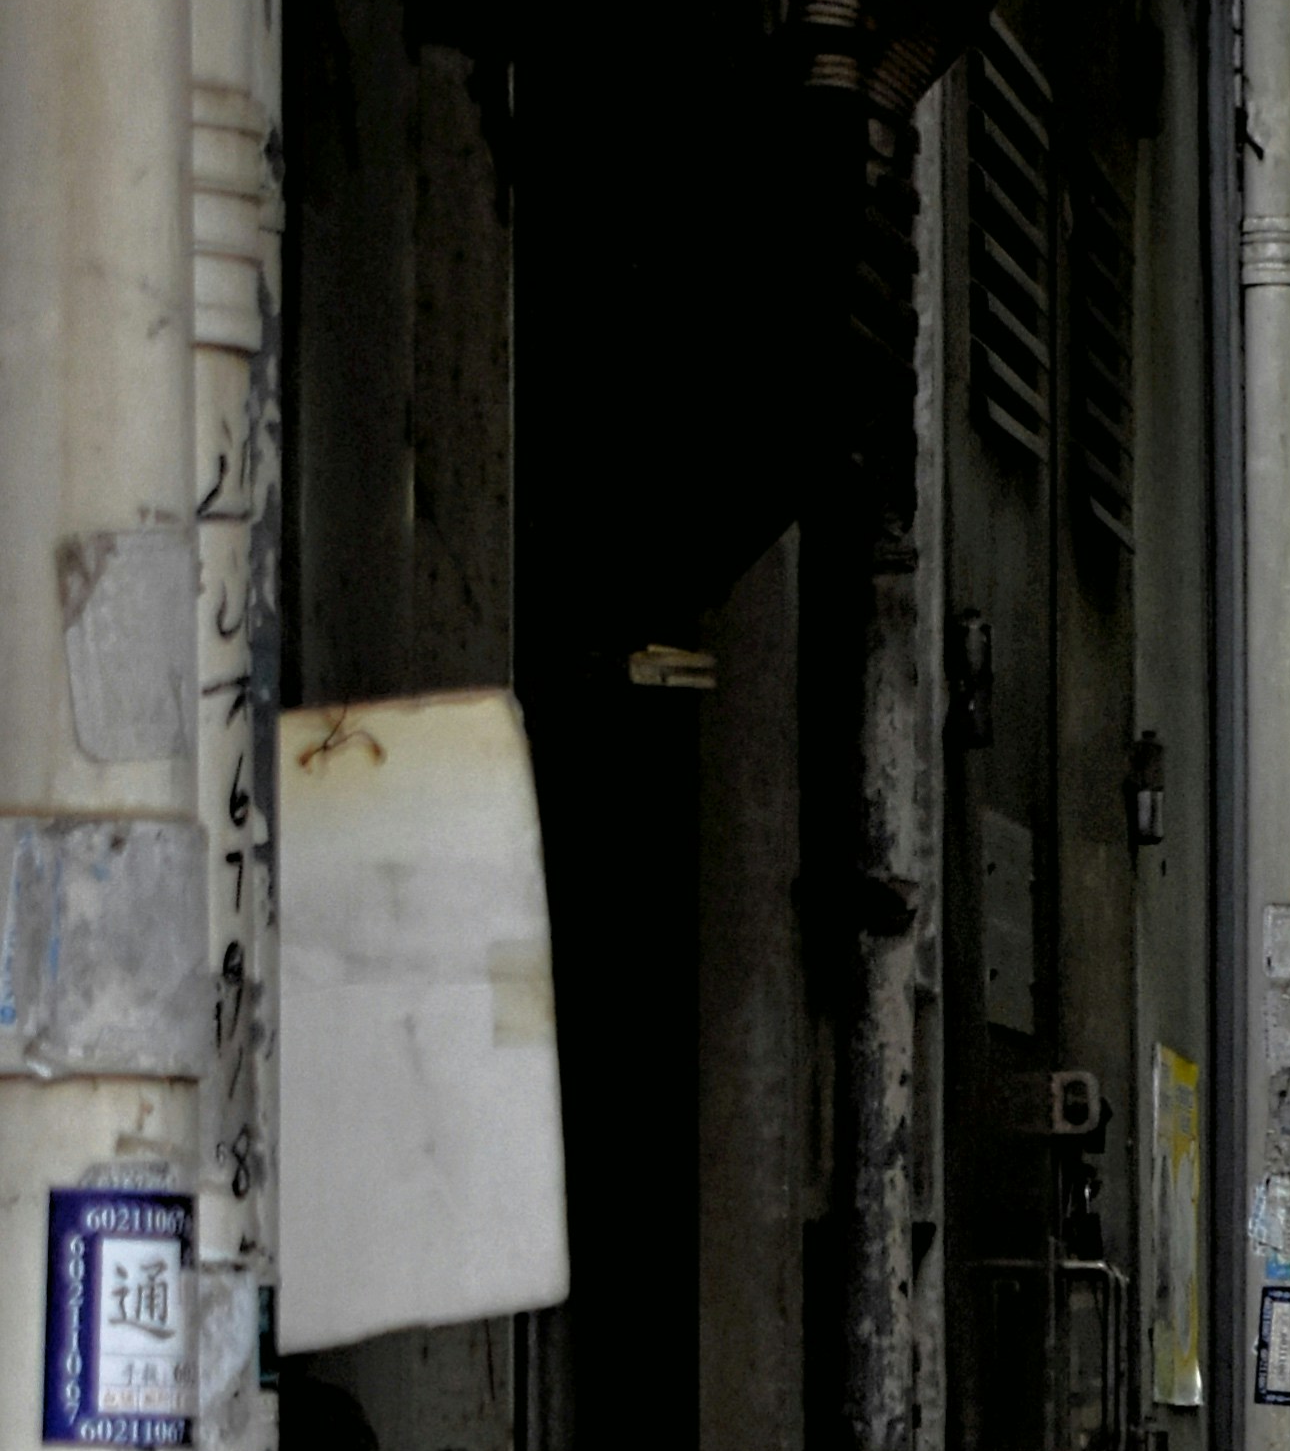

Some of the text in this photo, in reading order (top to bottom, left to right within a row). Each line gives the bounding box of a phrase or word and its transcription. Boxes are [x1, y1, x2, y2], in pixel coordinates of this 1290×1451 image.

[85, 1206, 185, 1232] 60211067
[108, 1257, 177, 1342] 通
[64, 1234, 86, 1426] 60211067
[80, 1417, 186, 1444] 60211067
